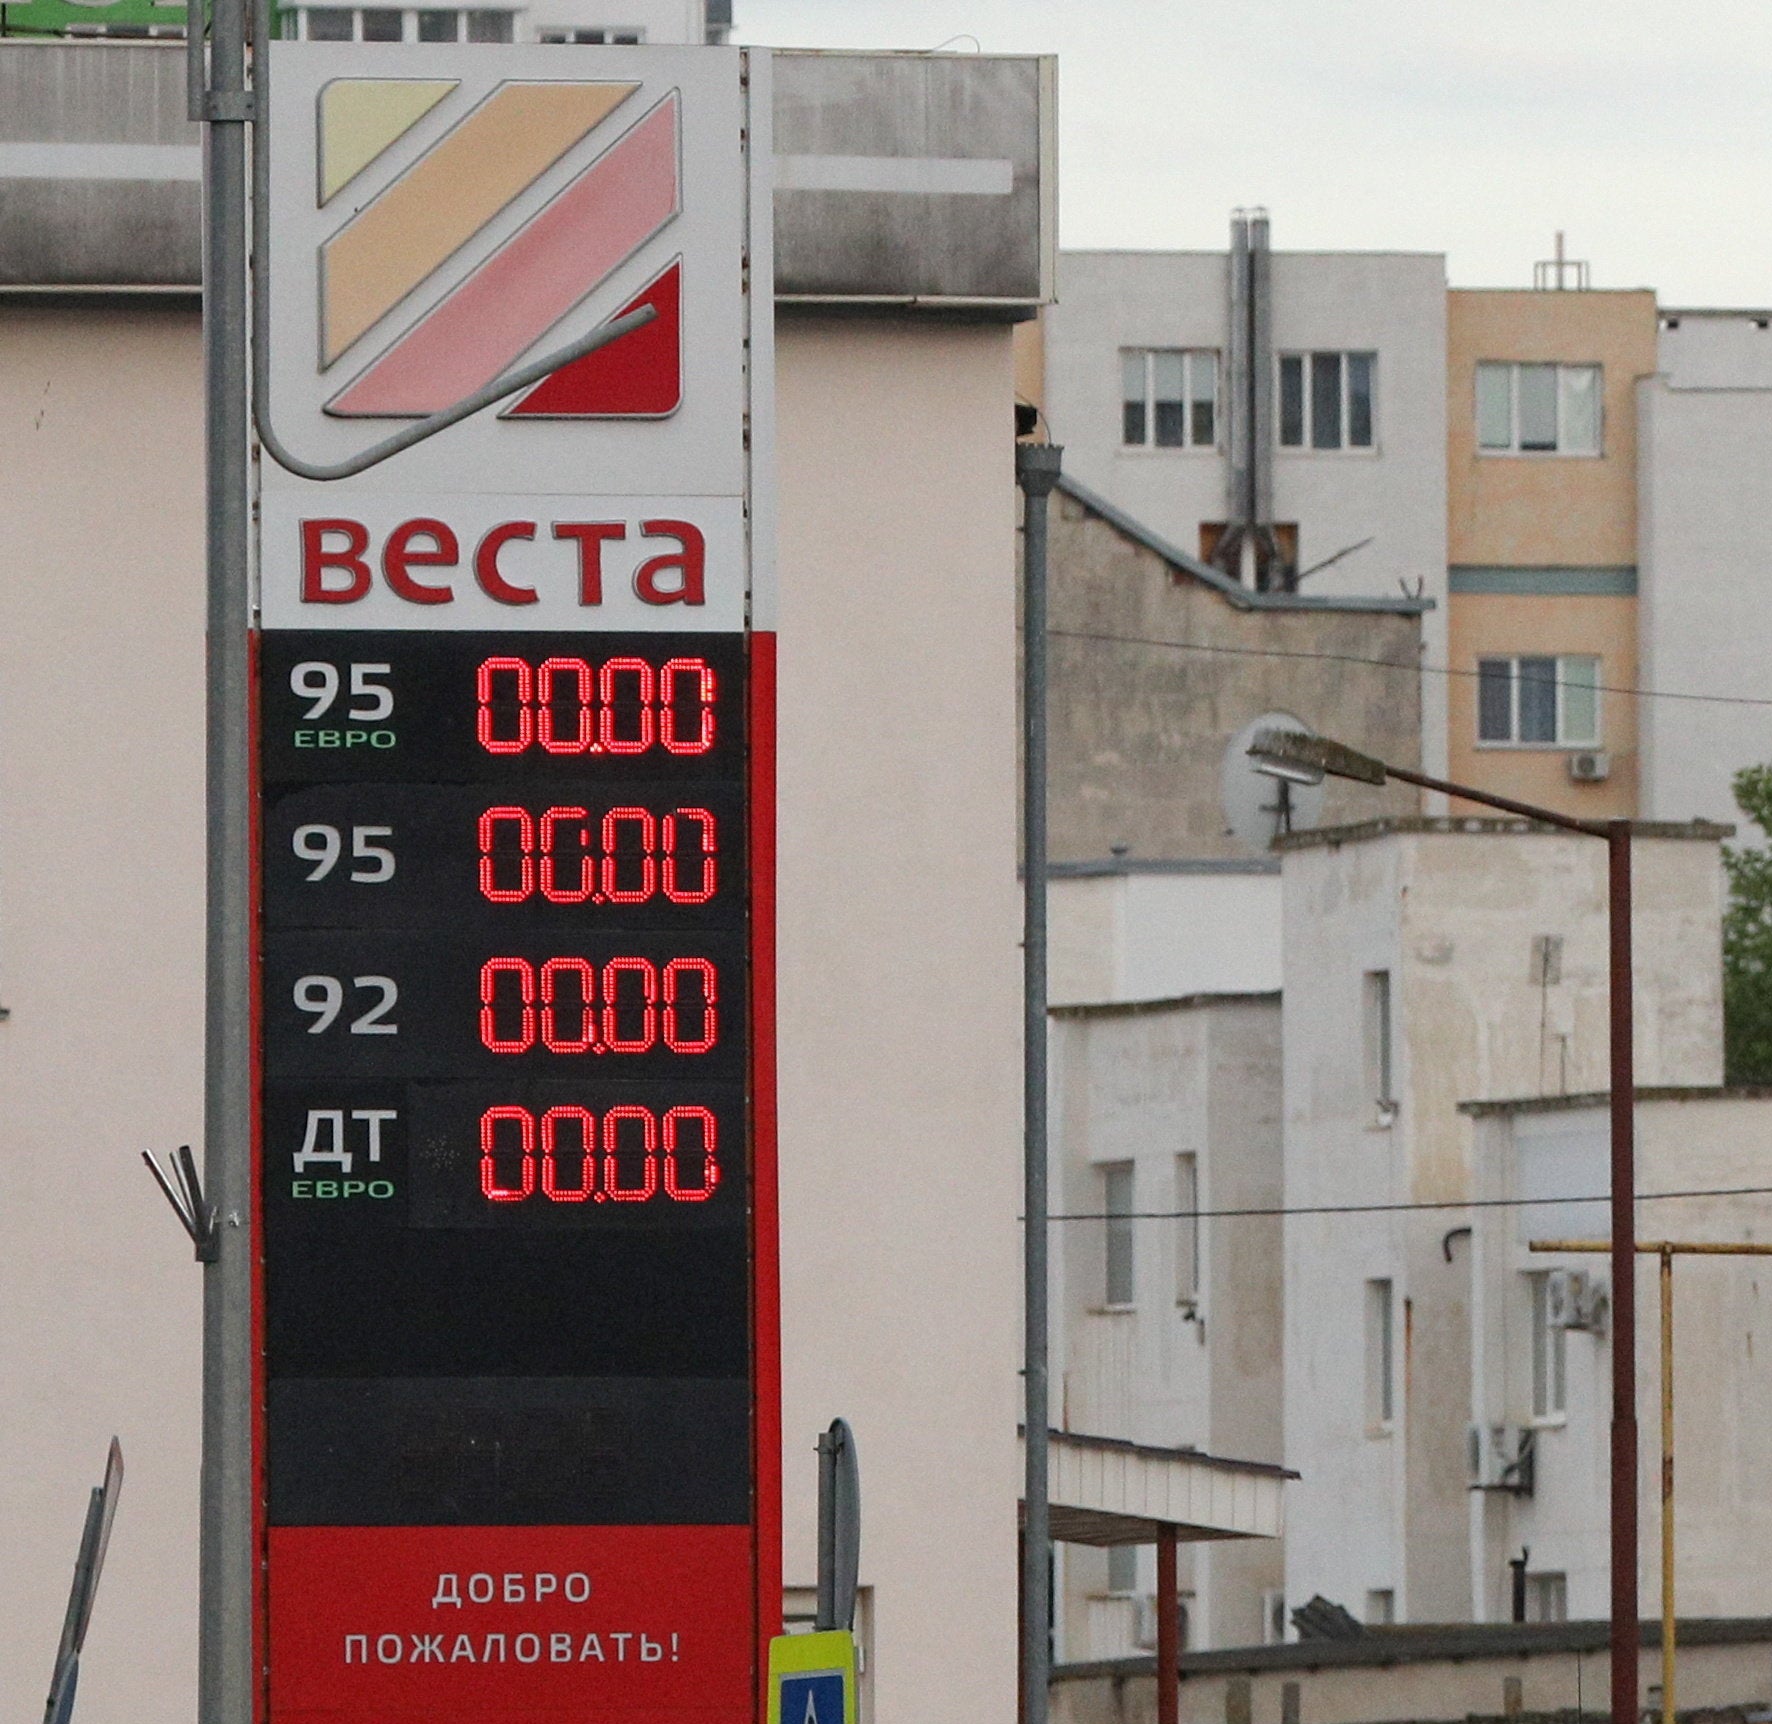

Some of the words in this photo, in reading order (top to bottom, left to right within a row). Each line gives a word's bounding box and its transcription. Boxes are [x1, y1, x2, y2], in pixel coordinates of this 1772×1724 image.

[289, 660, 394, 722] 95
[293, 728, 397, 749] ЕВРО
[291, 823, 396, 882] 95
[292, 974, 399, 1036] 92
[292, 1109, 397, 1173] ДТ
[291, 1179, 395, 1200] ЕВРО
[431, 1571, 592, 1609] ДОБРО
[343, 1631, 681, 1665] ПОЖАЛОВАТЬ!
